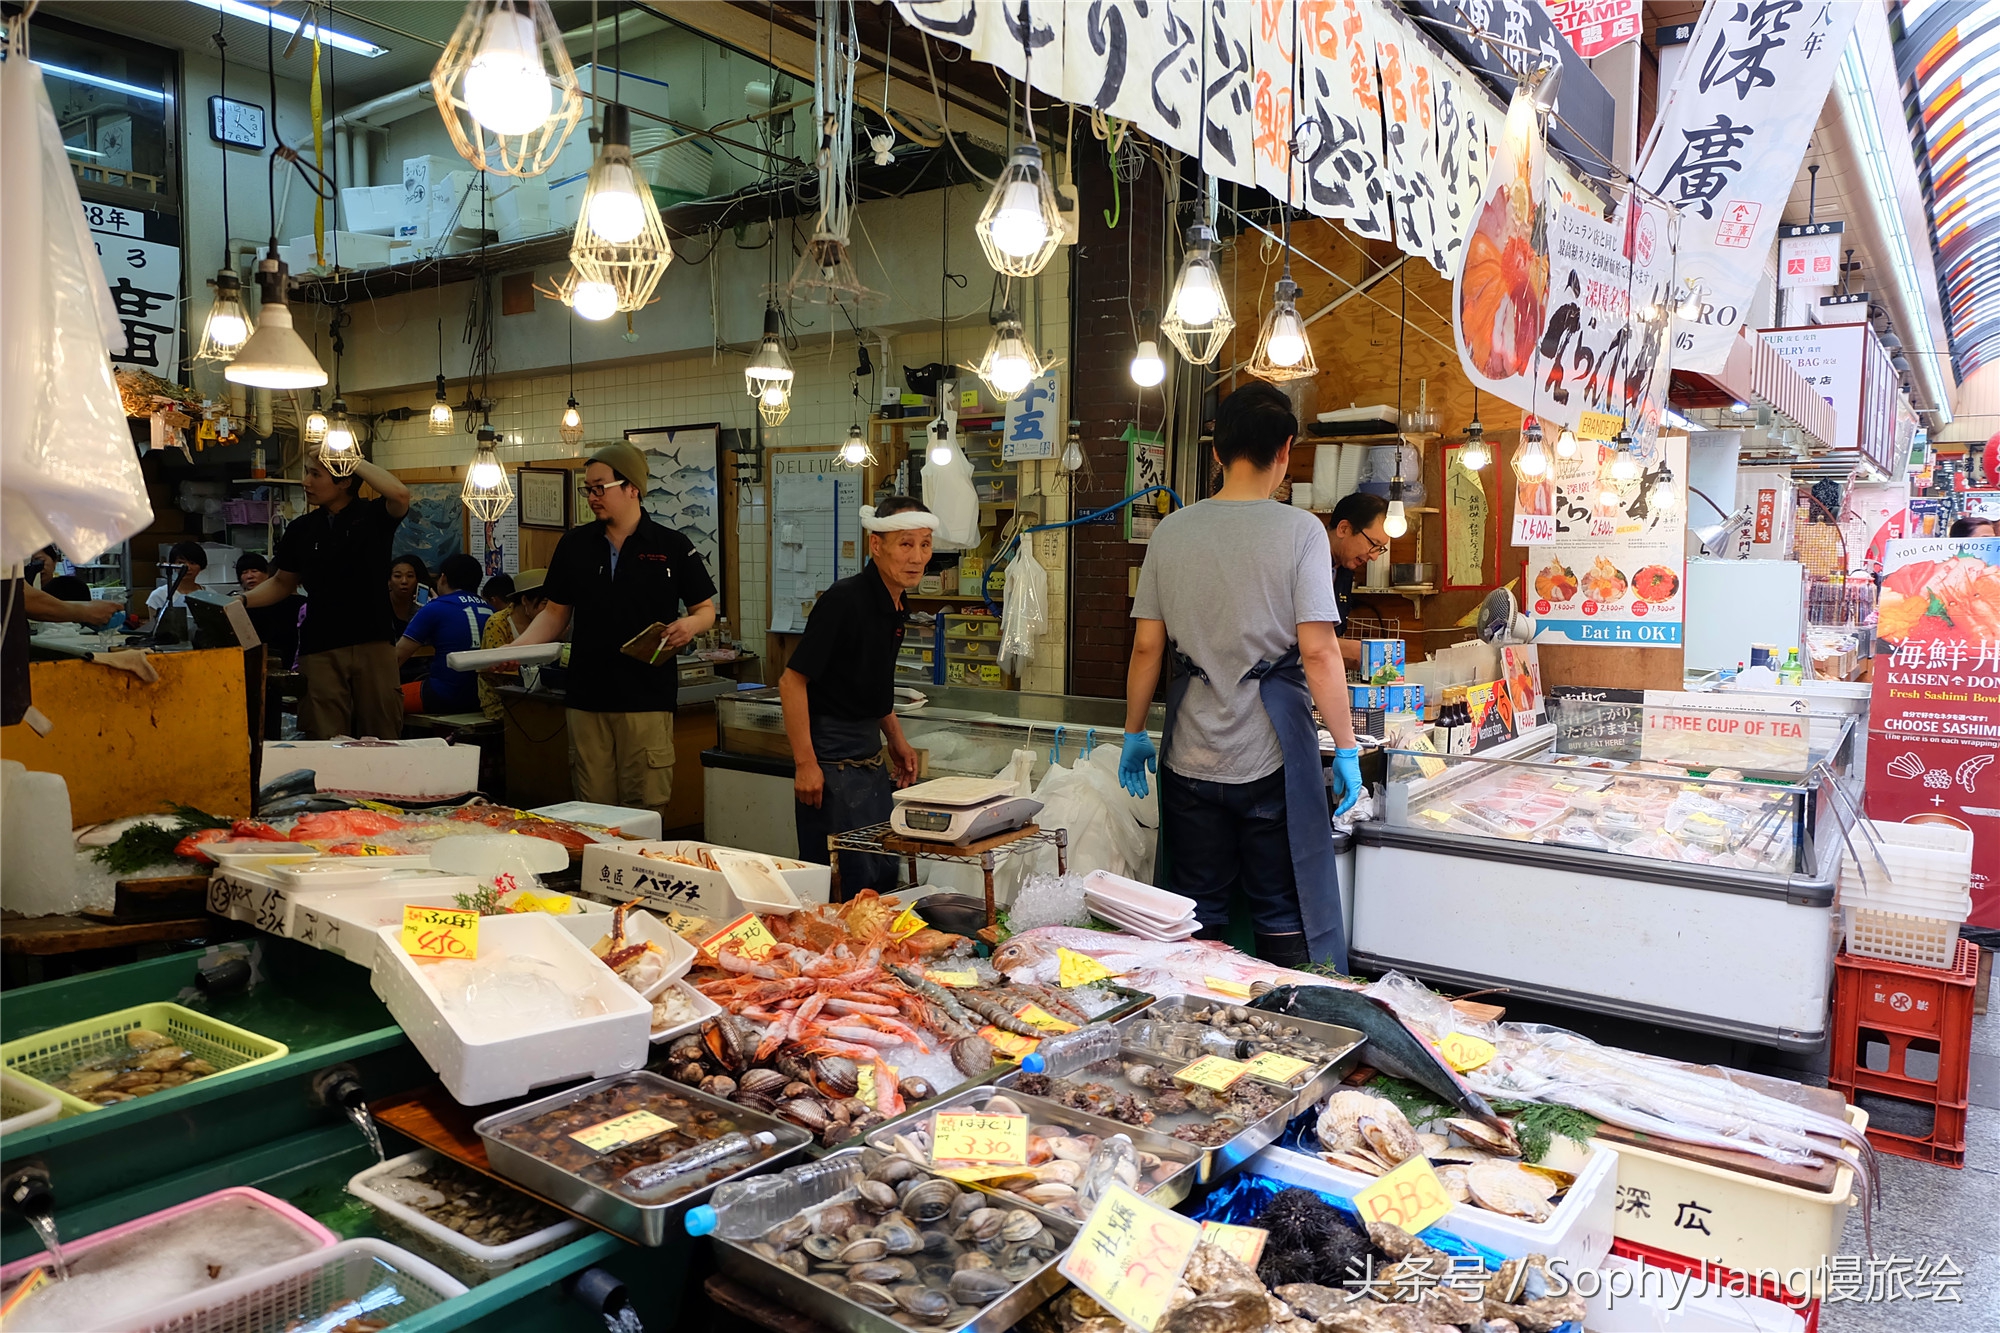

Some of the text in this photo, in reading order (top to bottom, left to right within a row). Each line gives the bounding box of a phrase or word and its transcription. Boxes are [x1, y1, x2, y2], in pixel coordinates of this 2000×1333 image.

[1698, 303, 1738, 328] RO
[1797, 357, 1821, 367] BAG
[1757, 492, 1773, 542] 伝承乃味
[1896, 543, 1992, 558] YOU CAN CHOOSE
[1581, 624, 1610, 640] Eat
[1616, 625, 1631, 640] in
[1886, 672, 1950, 687] KAISEN
[1889, 688, 1921, 700] Fresh
[1924, 690, 1968, 702] Sashimi
[1662, 715, 1702, 732] FREE
[1706, 718, 1739, 734] CUP
[1744, 721, 1765, 735] OF
[1770, 721, 1803, 738] TEA
[1884, 718, 1939, 733] CHOOSE
[1902, 734, 1921, 742] price
[954, 1135, 1011, 1155] 330
[1368, 1178, 1446, 1226] BBQ
[1616, 1184, 1713, 1237] 深広
